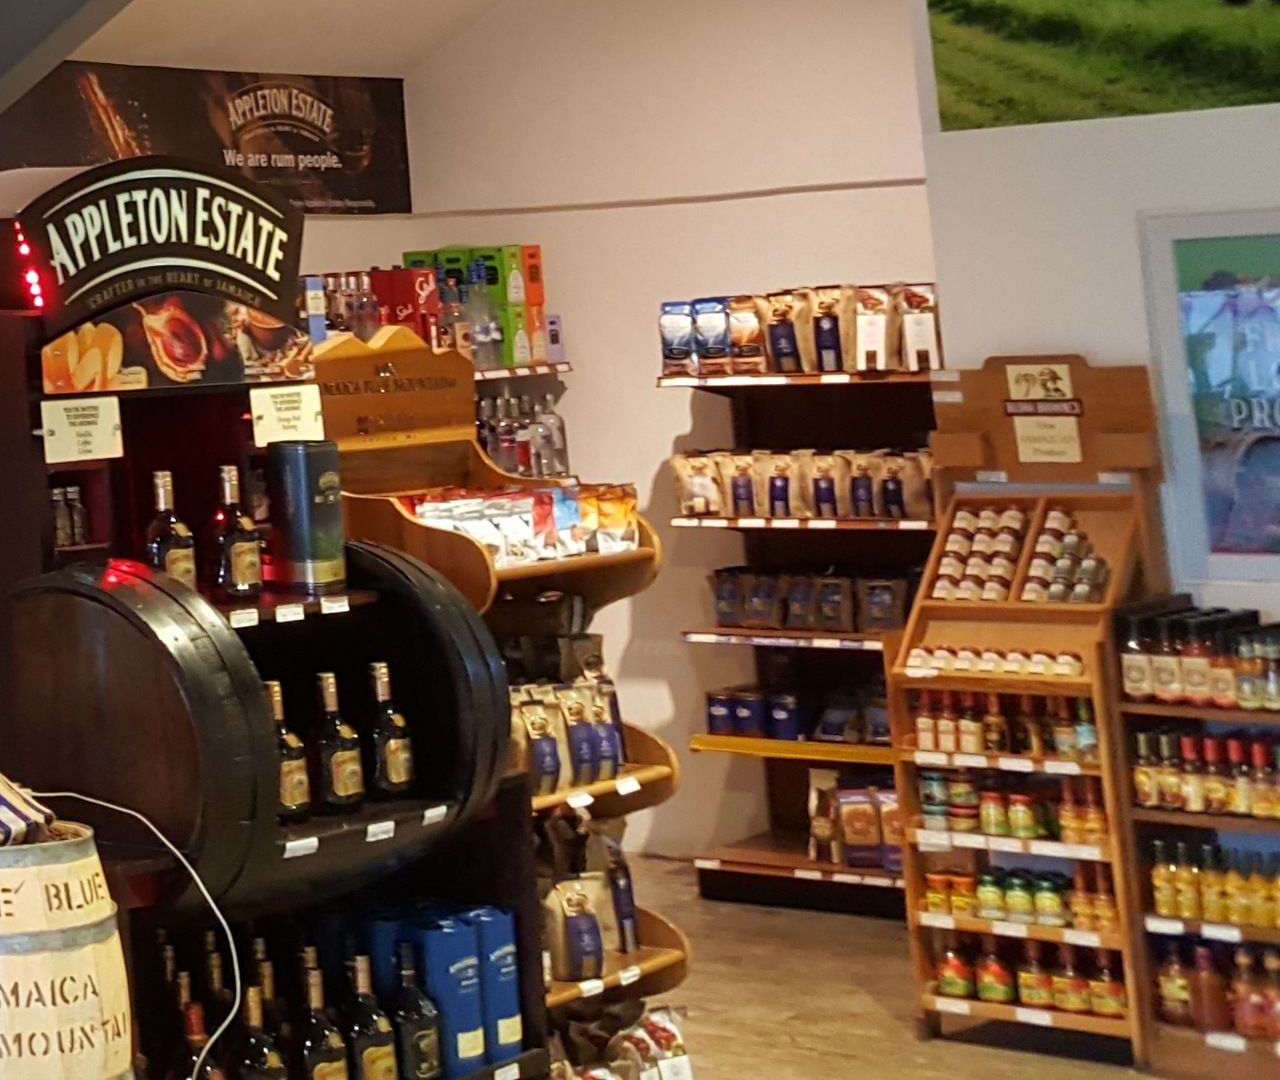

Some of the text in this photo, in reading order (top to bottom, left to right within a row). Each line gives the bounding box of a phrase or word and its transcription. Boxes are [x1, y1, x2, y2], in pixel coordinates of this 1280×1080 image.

[227, 87, 335, 133] APPLETON ESTATE
[222, 148, 343, 172] We are rum people.
[45, 185, 289, 286] APPLETON ESTATE
[165, 271, 201, 285] HEART
[45, 871, 107, 912] BLUE
